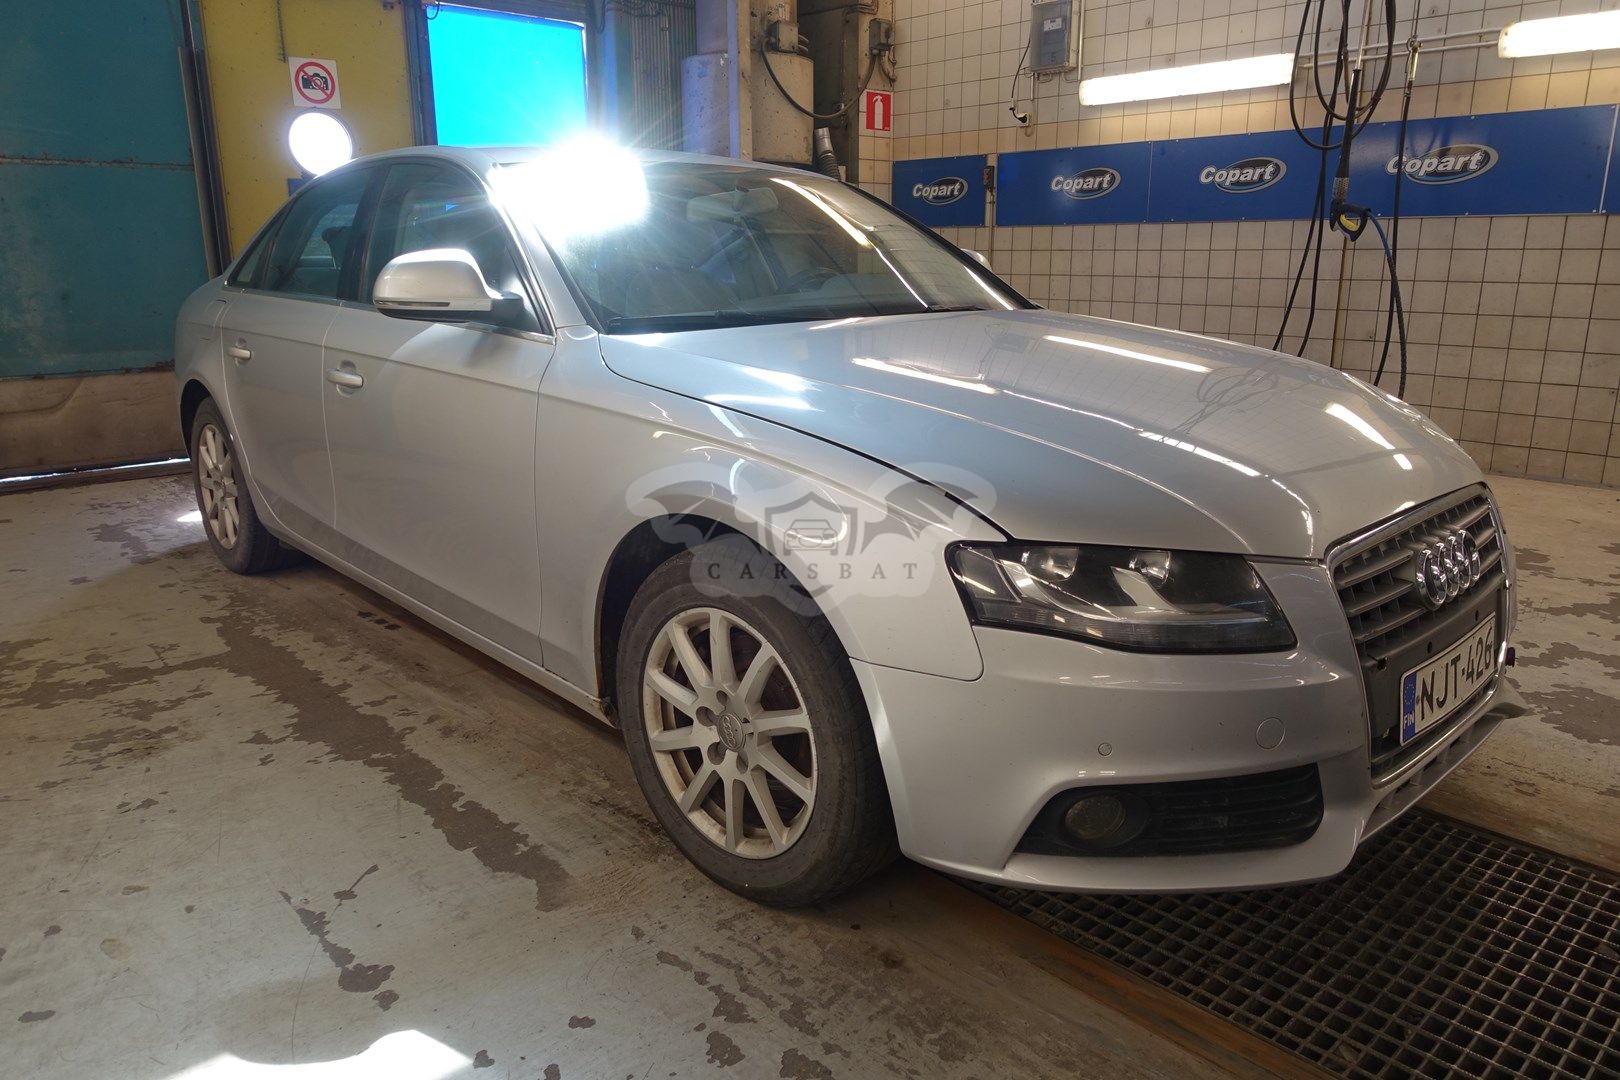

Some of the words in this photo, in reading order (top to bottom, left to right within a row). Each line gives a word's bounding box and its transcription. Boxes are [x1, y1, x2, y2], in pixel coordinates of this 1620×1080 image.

[1386, 149, 1485, 176] Copart
[1051, 171, 1112, 192] Copart
[1200, 162, 1276, 186] Copart
[912, 178, 961, 198] Copart
[1420, 627, 1493, 720] NJT-426
[1403, 711, 1415, 729] FIN
